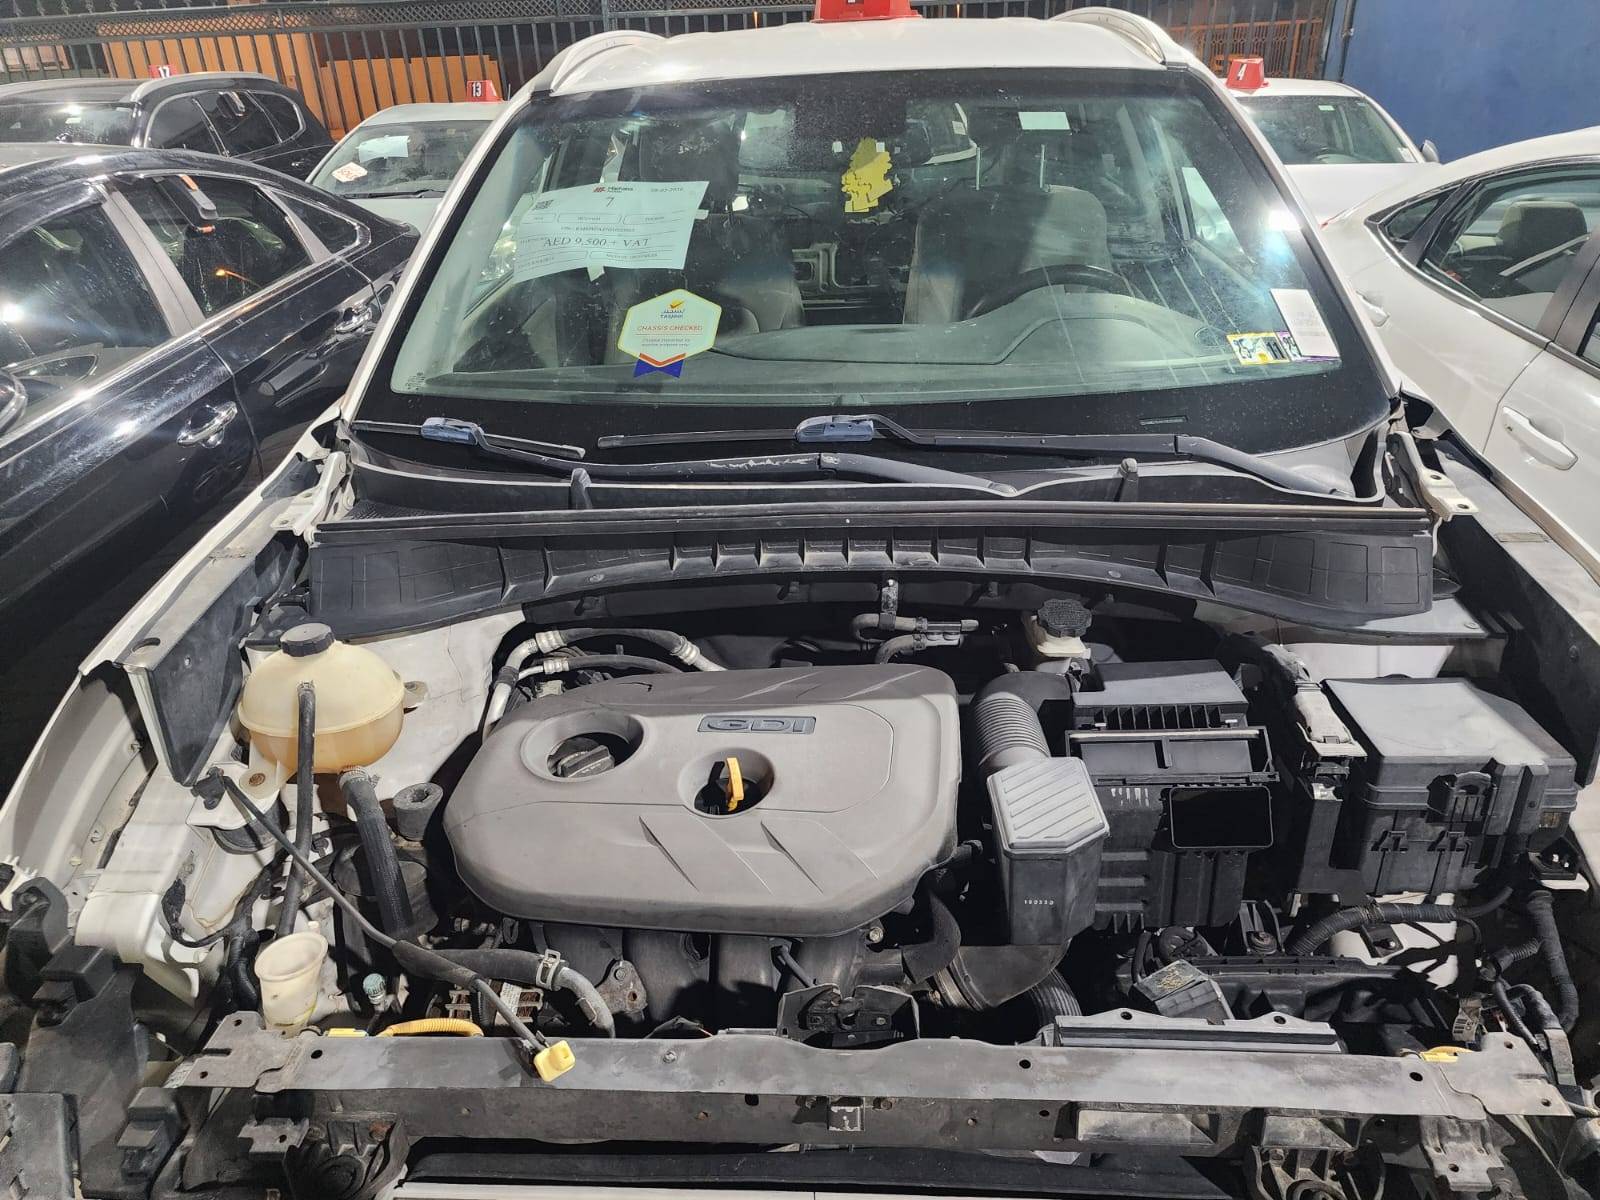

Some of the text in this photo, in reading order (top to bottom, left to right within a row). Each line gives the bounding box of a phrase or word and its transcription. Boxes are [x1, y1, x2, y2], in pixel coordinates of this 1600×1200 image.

[1236, 63, 1248, 81] 4
[472, 81, 482, 97] 13
[606, 196, 614, 208] 7
[544, 236, 571, 247] AED
[623, 237, 649, 247] VAT
[1265, 341, 1286, 359] 11
[706, 718, 806, 732] GDI
